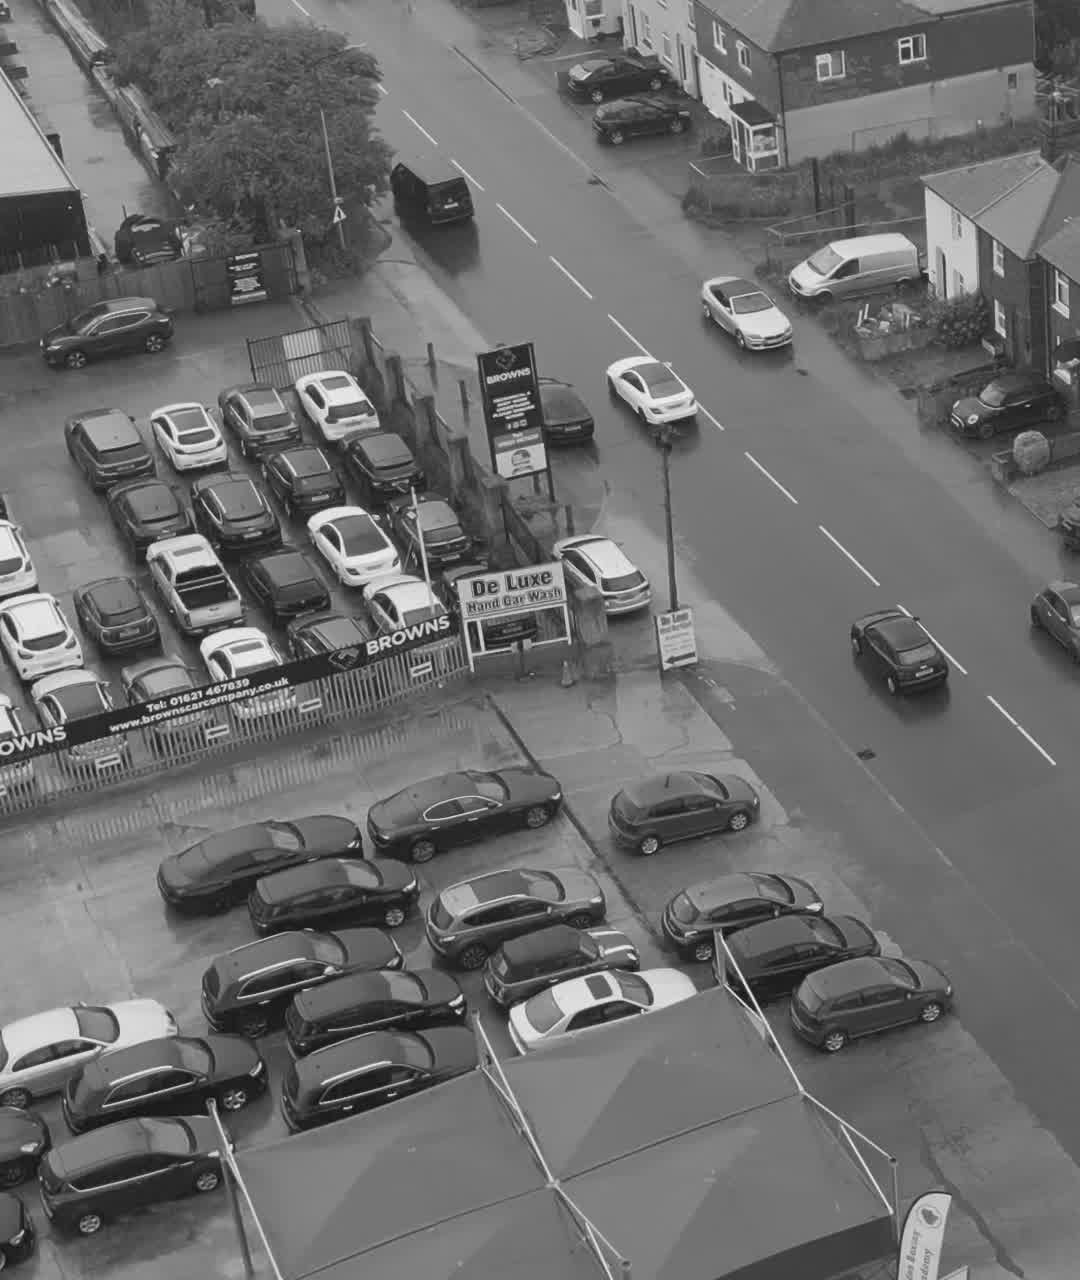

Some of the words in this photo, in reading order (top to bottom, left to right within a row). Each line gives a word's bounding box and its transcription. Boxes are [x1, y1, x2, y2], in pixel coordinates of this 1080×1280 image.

[486, 368, 531, 384] BROWNS
[471, 579, 498, 597] De
[505, 570, 553, 591] Luxe
[466, 599, 500, 614] Hand
[501, 594, 526, 607] Car
[526, 587, 563, 603] Wash
[366, 614, 450, 656] BROWNS
[109, 677, 289, 733] www.brownscarcompany.co.uk
[146, 699, 168, 713] Tel:
[170, 690, 203, 707] 01621
